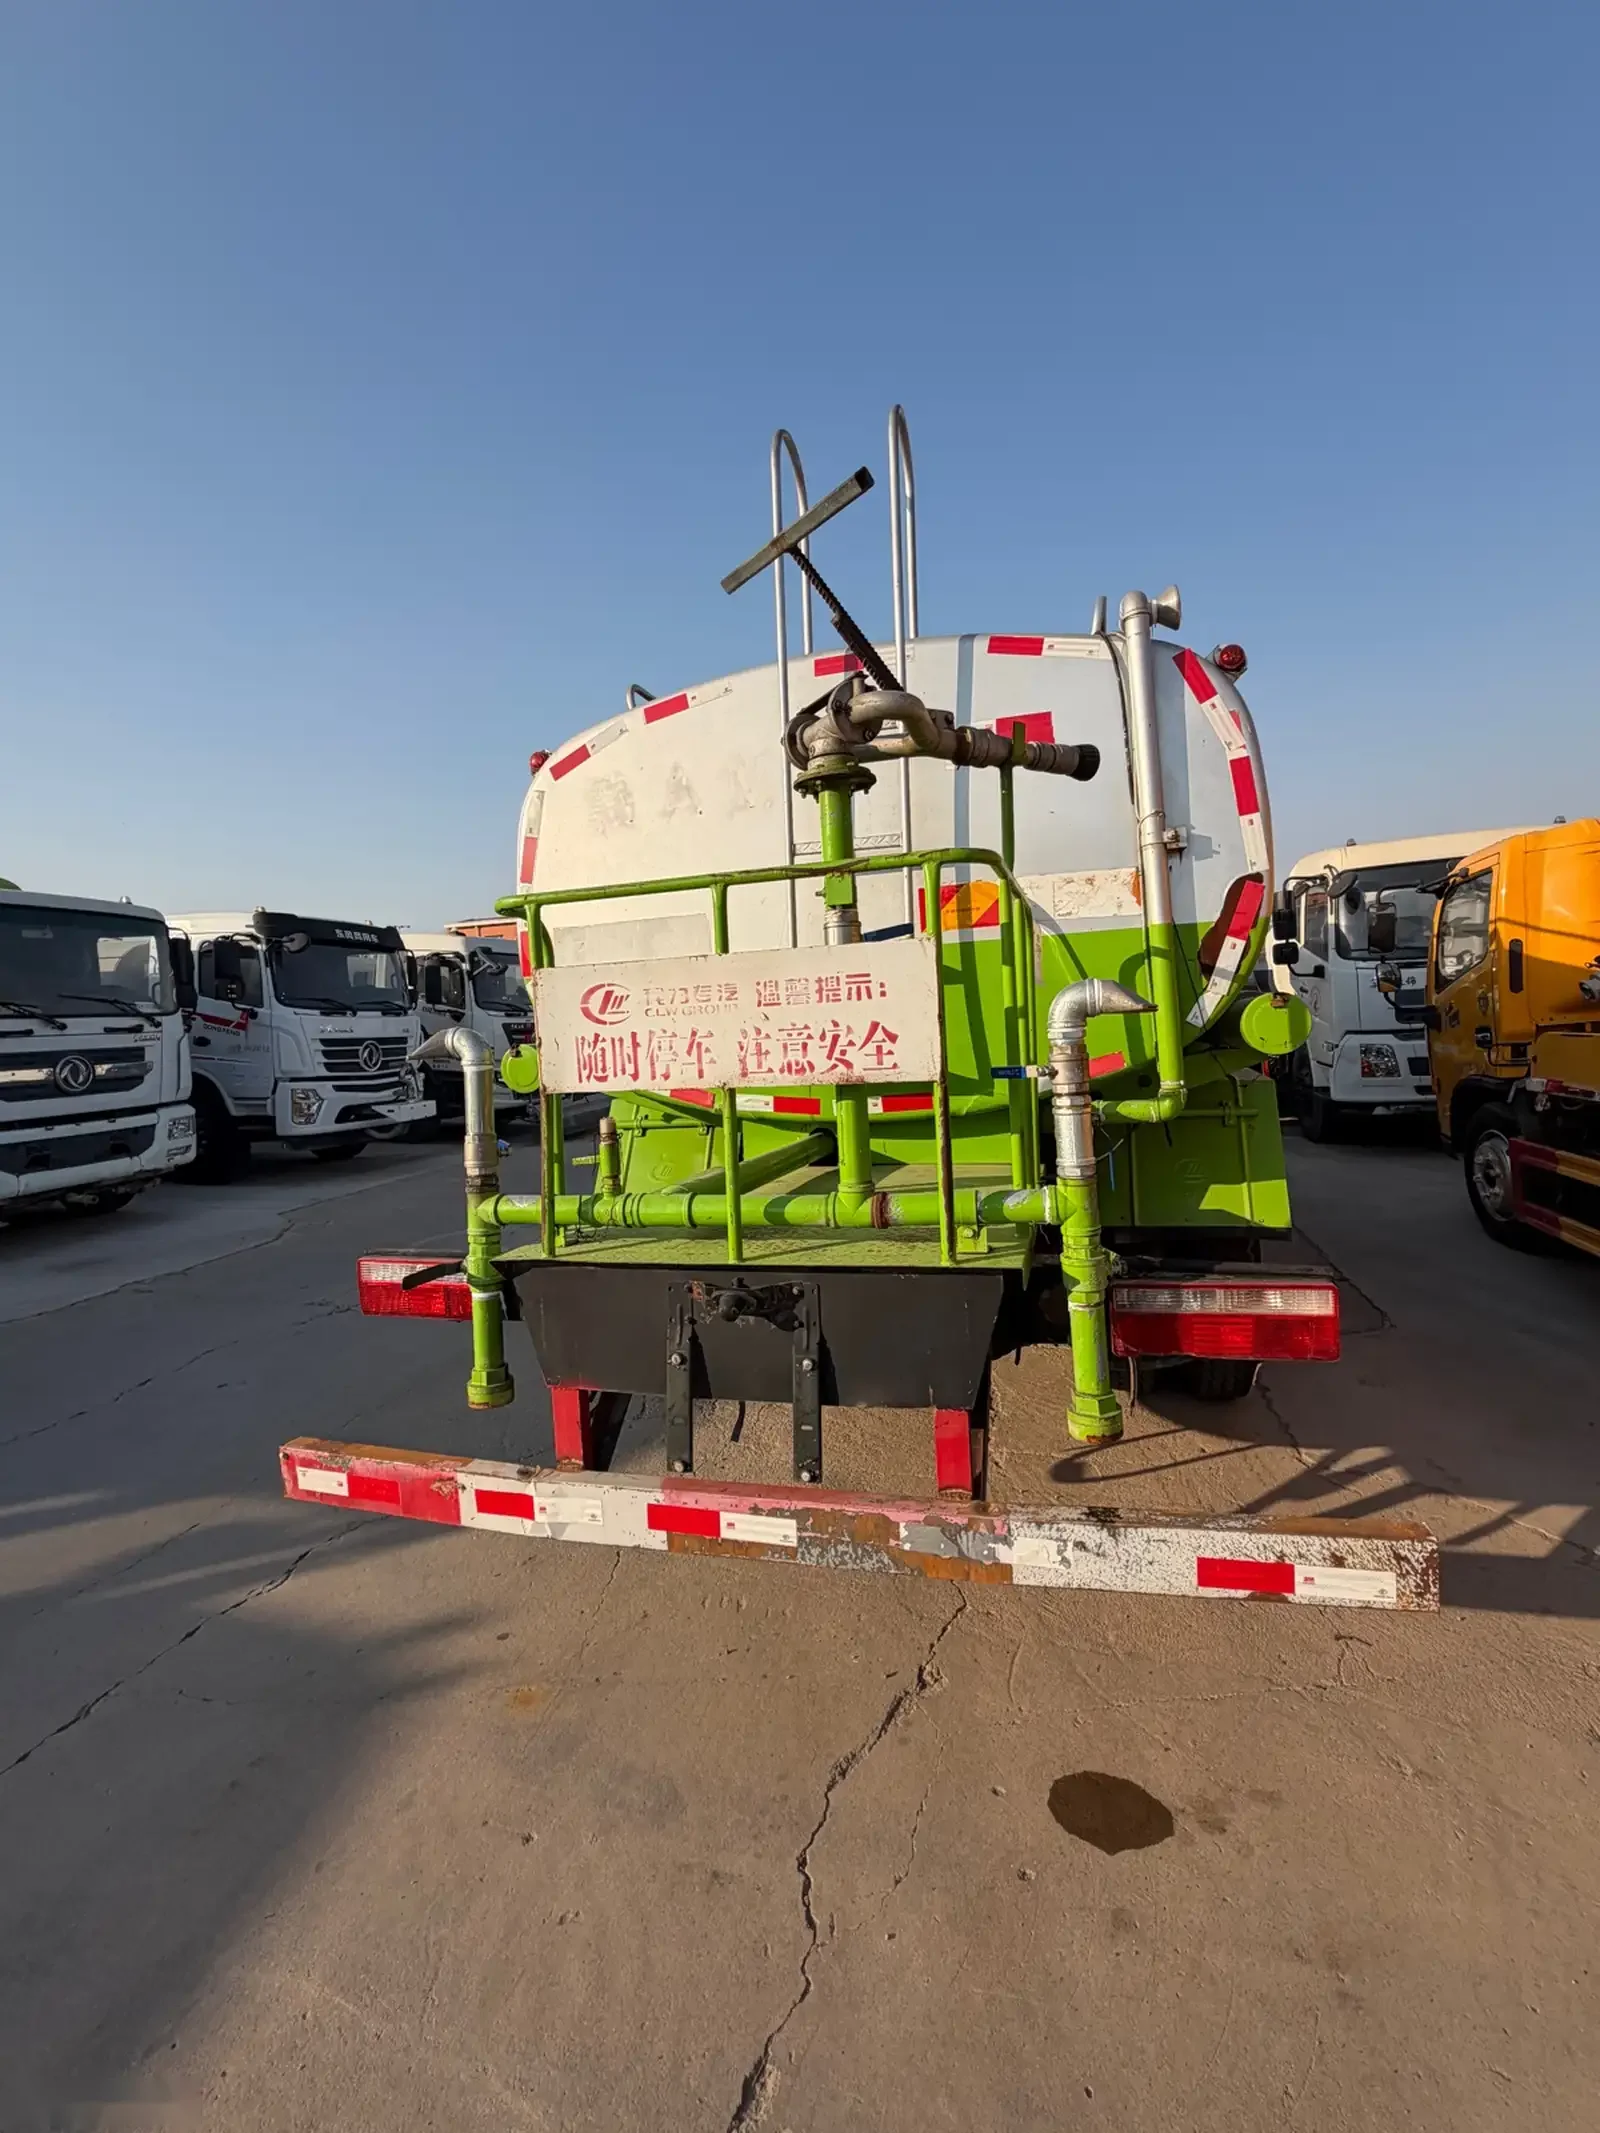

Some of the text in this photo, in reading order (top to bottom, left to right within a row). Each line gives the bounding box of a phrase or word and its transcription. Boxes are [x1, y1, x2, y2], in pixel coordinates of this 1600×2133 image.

[644, 1007, 678, 1018] CLW
[575, 1020, 900, 1084] 随时停车 注意安全
